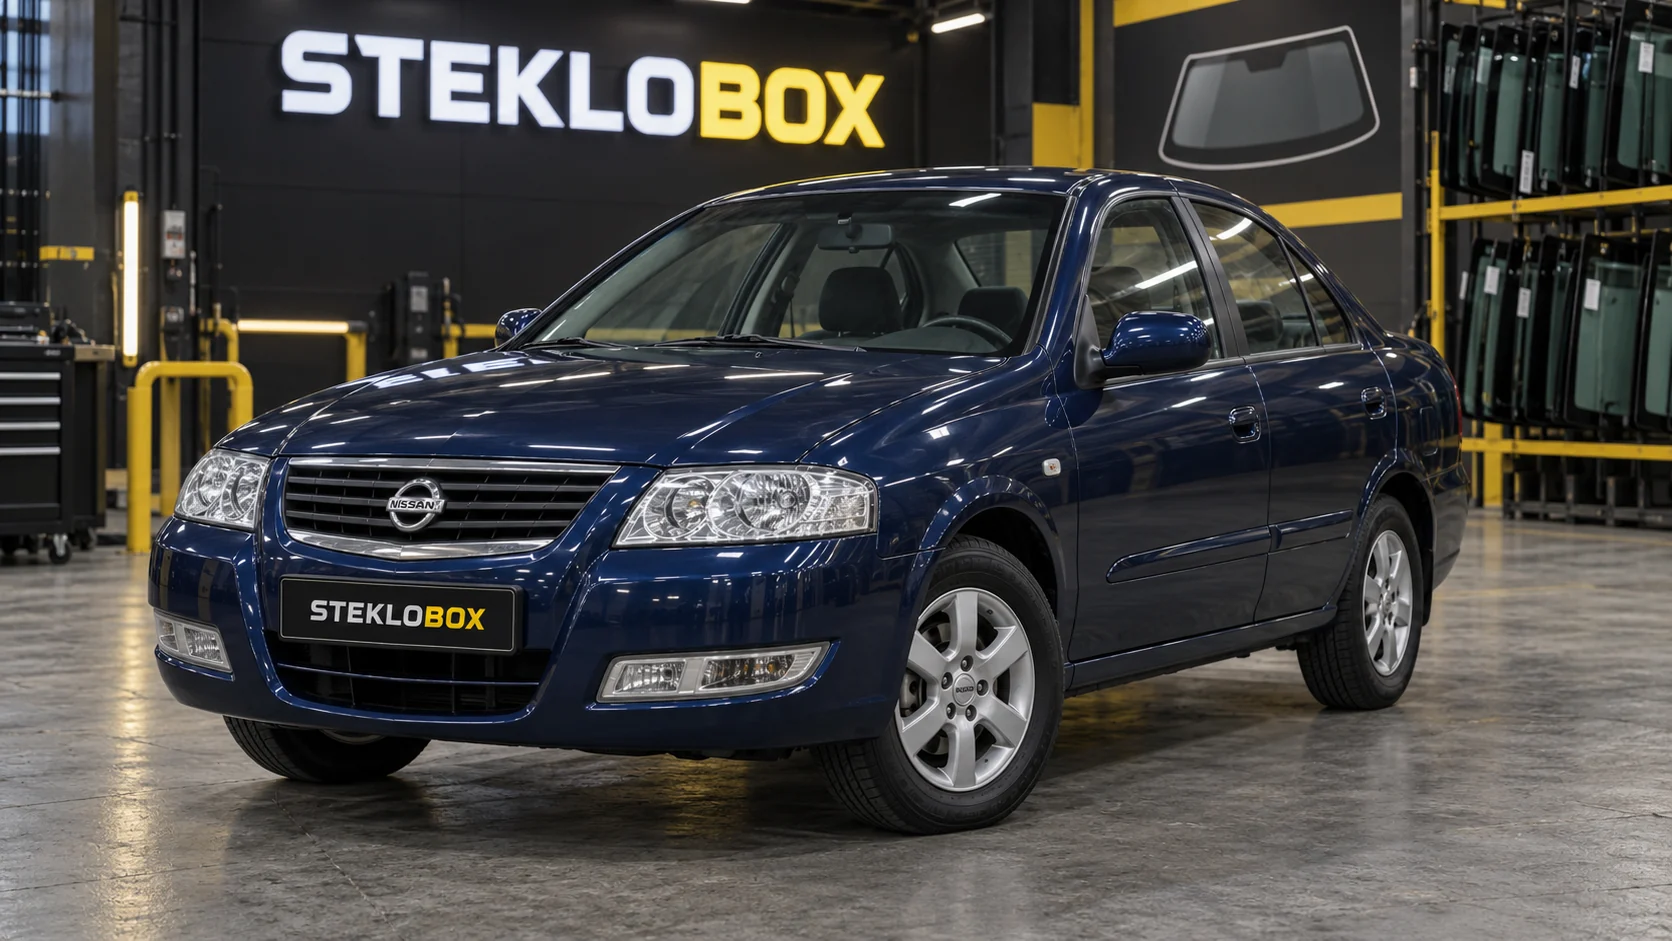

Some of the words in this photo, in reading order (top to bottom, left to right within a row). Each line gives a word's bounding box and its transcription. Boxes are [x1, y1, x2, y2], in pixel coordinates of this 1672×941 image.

[281, 29, 885, 148] STEKLOBOX
[389, 500, 435, 510] NISSAN
[310, 600, 486, 631] STEKLOBOX
